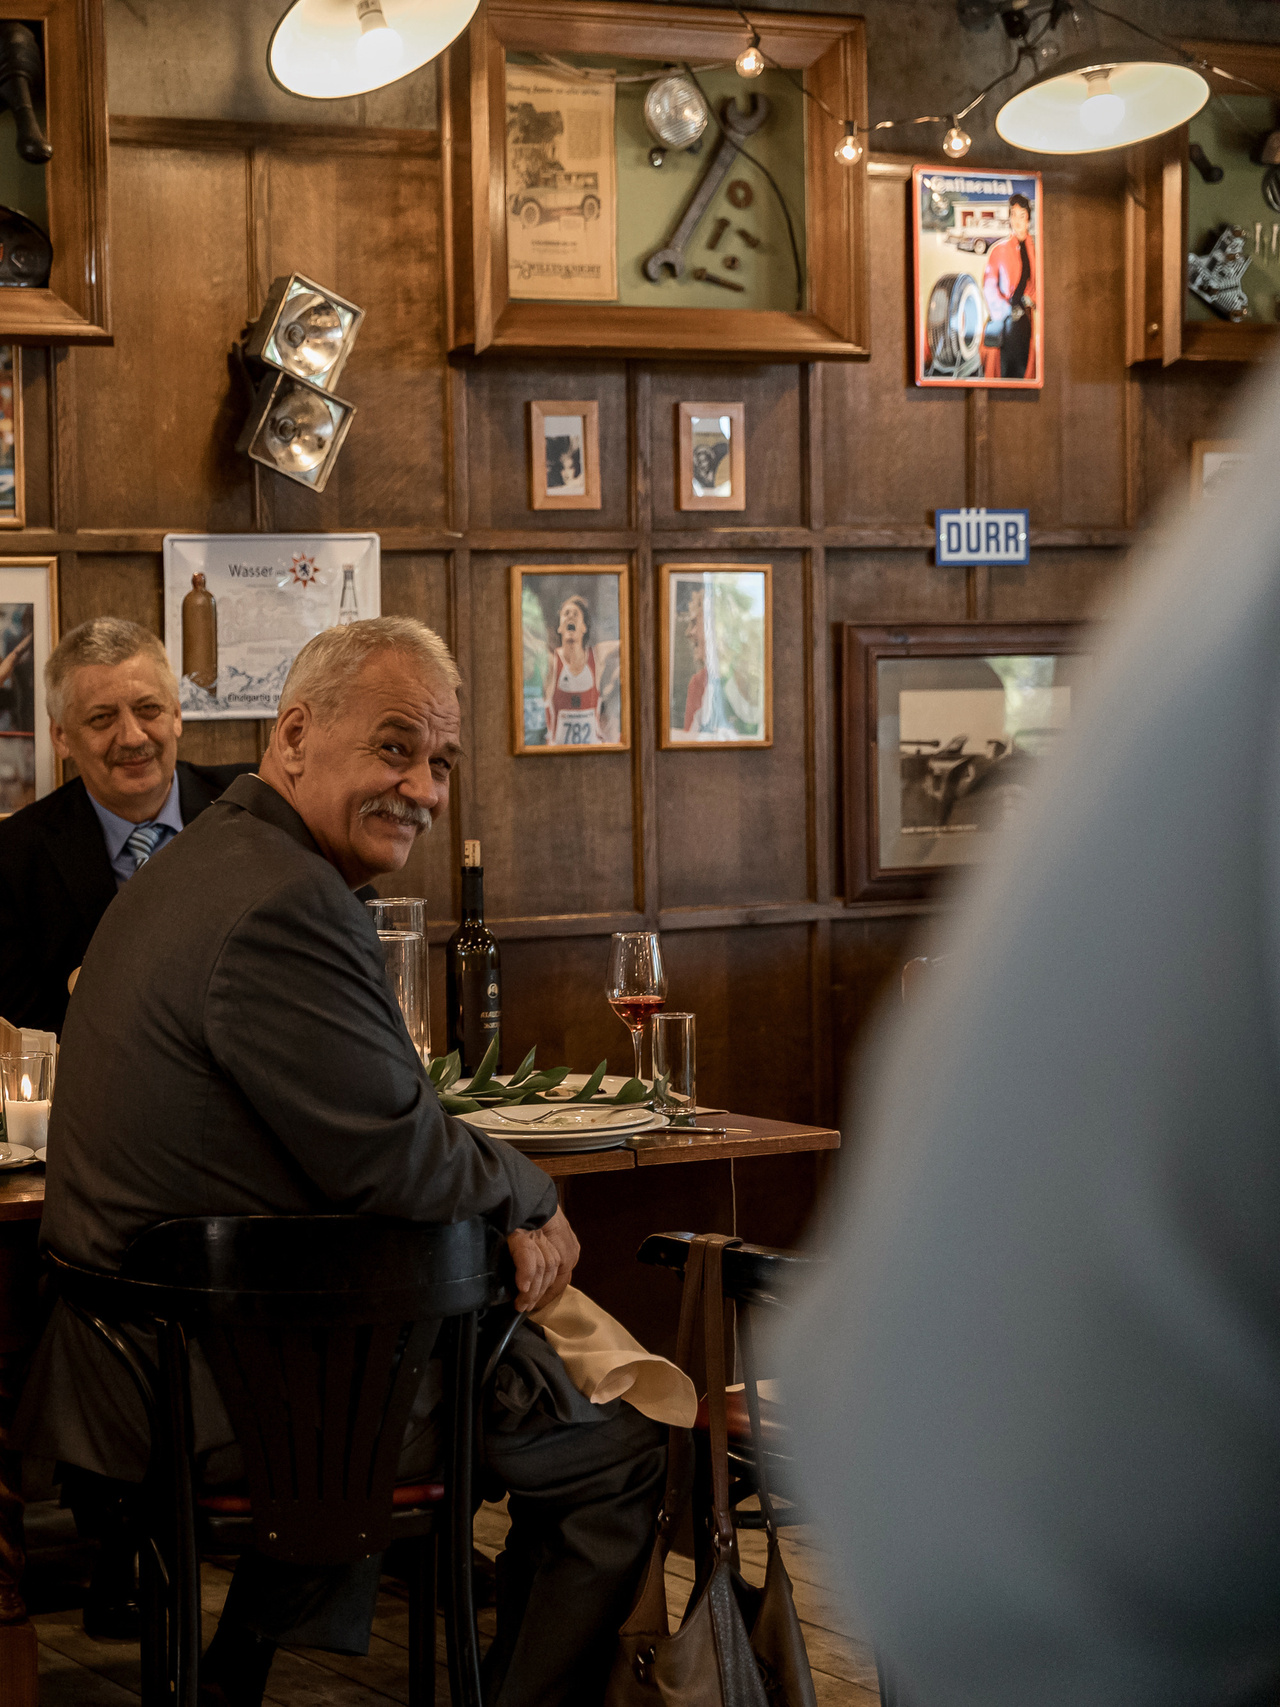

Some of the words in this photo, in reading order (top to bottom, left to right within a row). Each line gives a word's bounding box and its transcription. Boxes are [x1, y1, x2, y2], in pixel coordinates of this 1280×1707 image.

[930, 175, 1014, 196] Continental
[946, 511, 1020, 553] DÜRR
[228, 564, 273, 578] Wasser
[563, 722, 592, 744] 782
